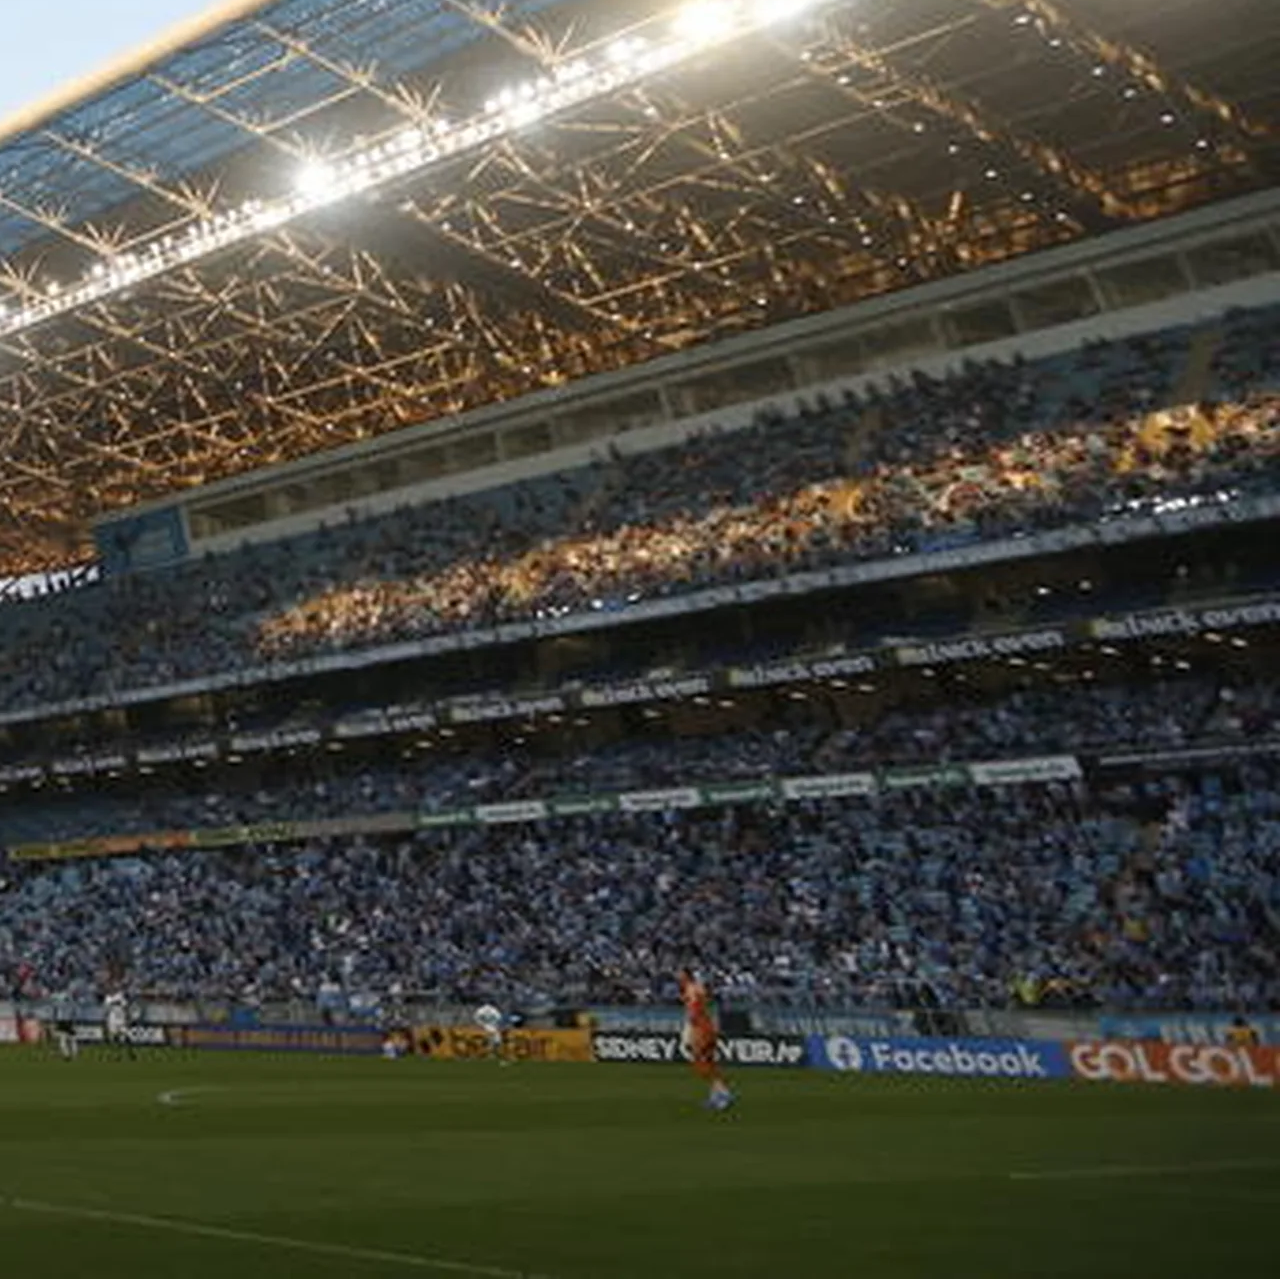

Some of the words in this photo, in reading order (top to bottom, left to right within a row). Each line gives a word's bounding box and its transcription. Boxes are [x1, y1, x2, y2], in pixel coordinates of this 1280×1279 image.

[594, 1034, 677, 1061] SIDNEY
[869, 1042, 1047, 1078] Facebook
[1070, 1044, 1168, 1082] GOL
[1168, 1045, 1274, 1087] GOL
